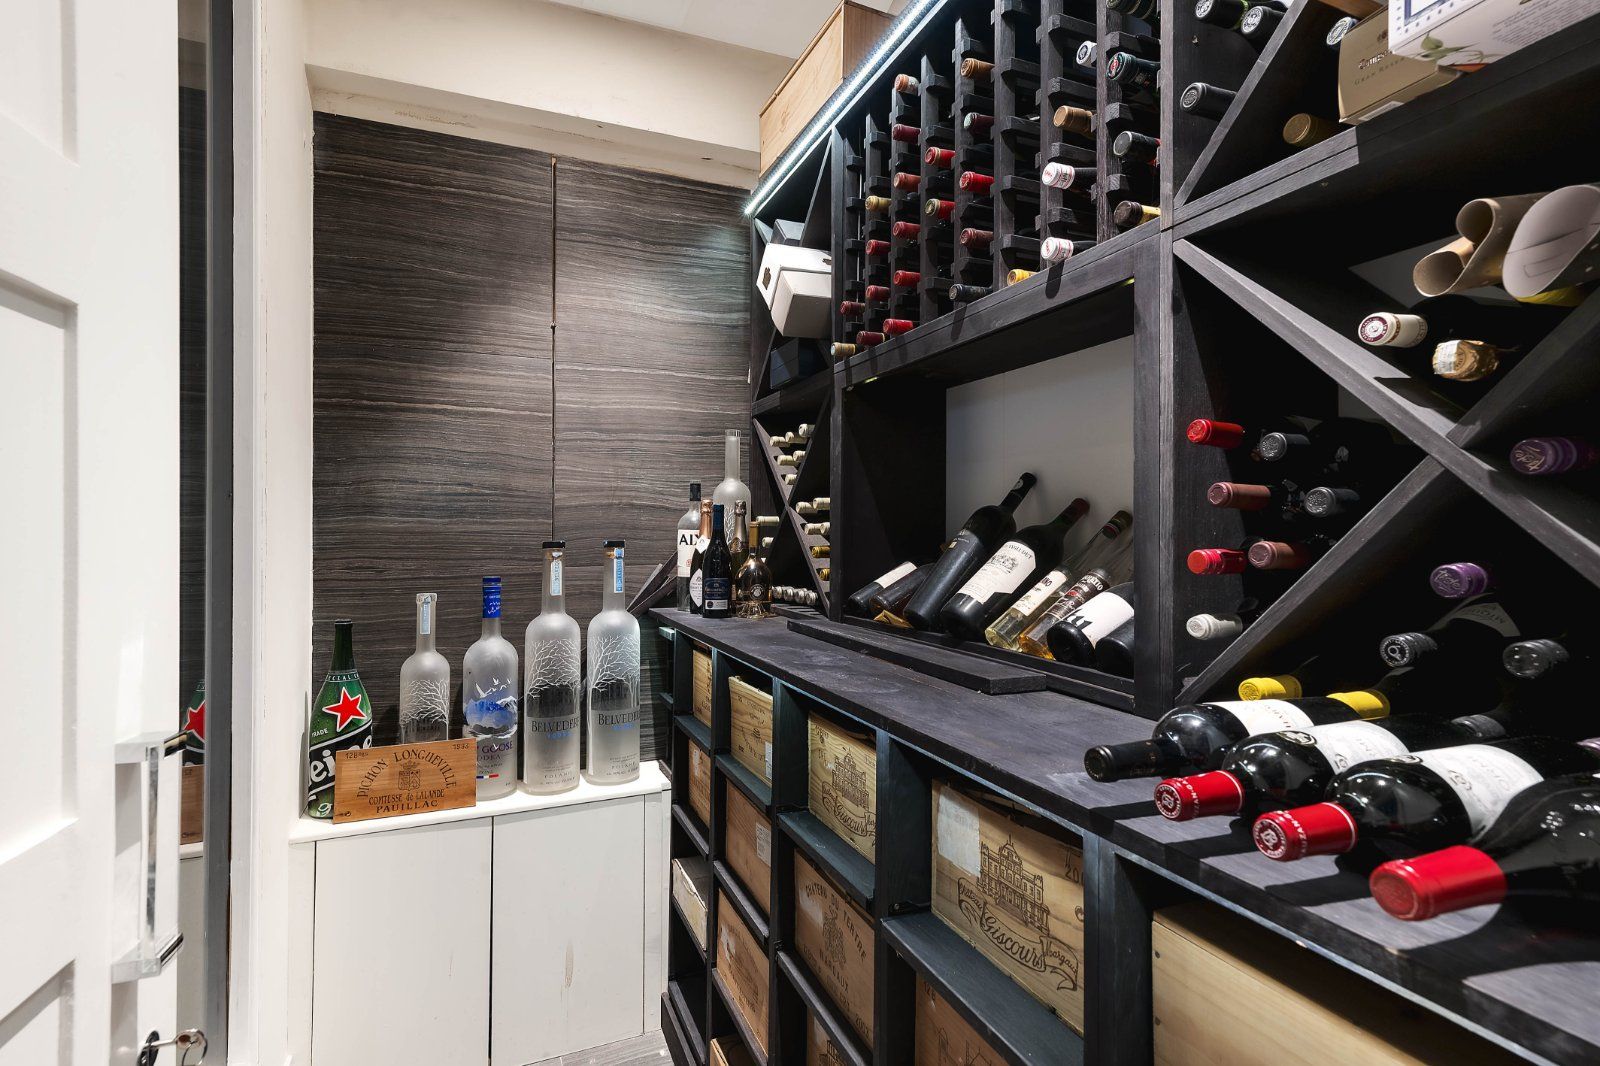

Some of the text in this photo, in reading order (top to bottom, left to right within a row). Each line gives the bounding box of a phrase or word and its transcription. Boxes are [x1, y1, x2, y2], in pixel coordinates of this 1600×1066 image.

[357, 748, 457, 797] PICHON LONGUEVILLE
[368, 788, 445, 806] COMTESSE de LALANDE
[376, 800, 438, 814] PAUILLAC
[843, 910, 867, 962] TERTRE
[981, 911, 1043, 968] Giscours
